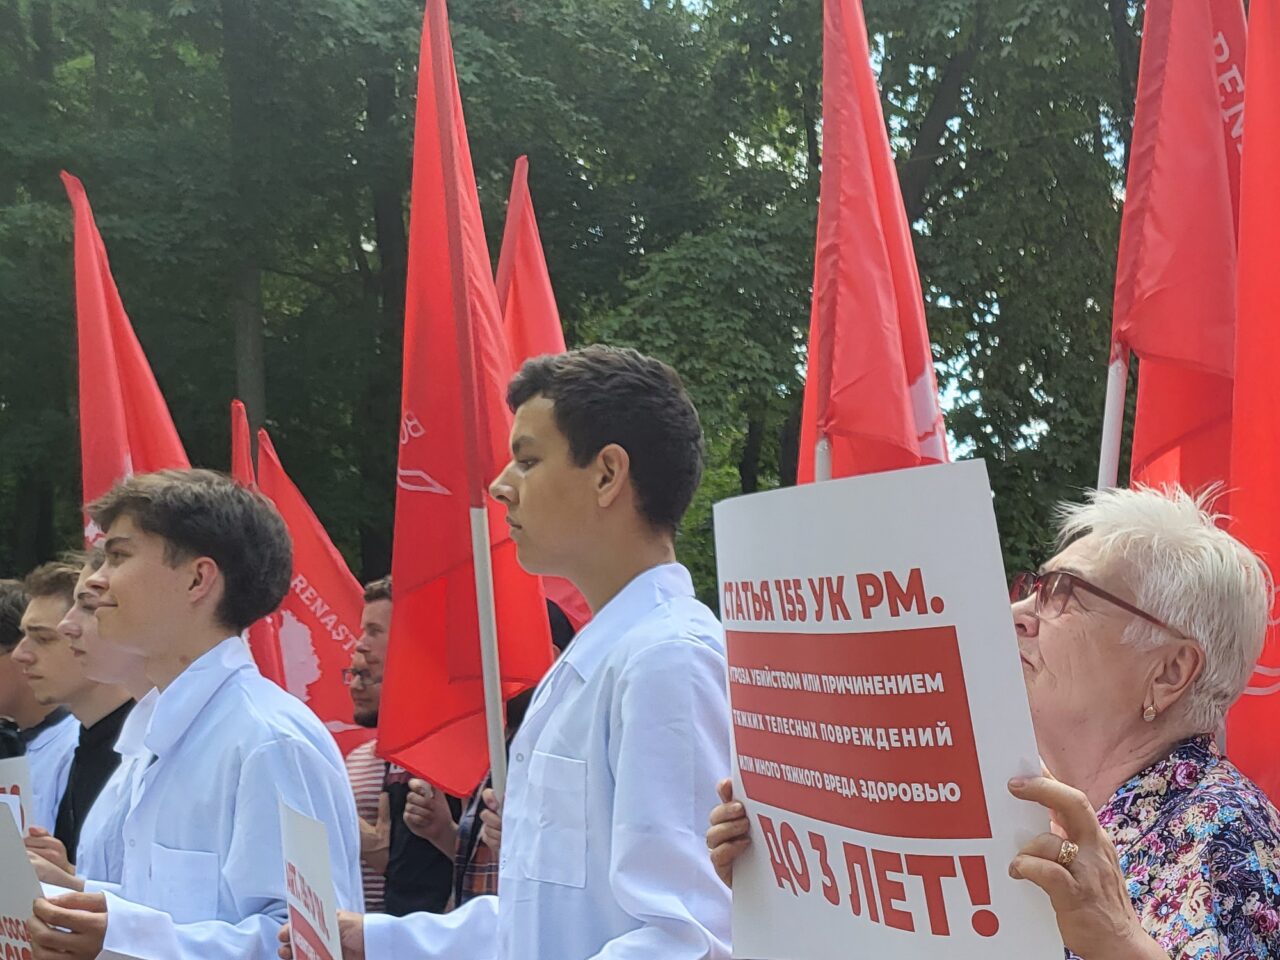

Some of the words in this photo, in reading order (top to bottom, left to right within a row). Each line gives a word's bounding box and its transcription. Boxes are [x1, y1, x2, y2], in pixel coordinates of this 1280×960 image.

[724, 580, 775, 621] СТАТЬЯ
[775, 578, 807, 622] 155
[808, 575, 852, 622] УК
[856, 567, 945, 620] РМ.
[750, 666, 802, 690] УБИЙСТВОМ
[802, 673, 821, 692] ИЛИ
[821, 672, 945, 696] ПРИЧИНЕНИЕМ
[765, 714, 819, 739] ТЕЛЕСНЫХ
[820, 721, 954, 750] ПОВРЕЖДЕНИЙ
[780, 763, 823, 789] ТЯЖКОГО
[823, 773, 859, 799] ВРЕДА
[859, 779, 961, 803] ЗДОРОВЬЮ
[757, 813, 811, 897] ДО
[808, 830, 840, 906] 3
[842, 841, 1000, 938] ЛЕТ!
